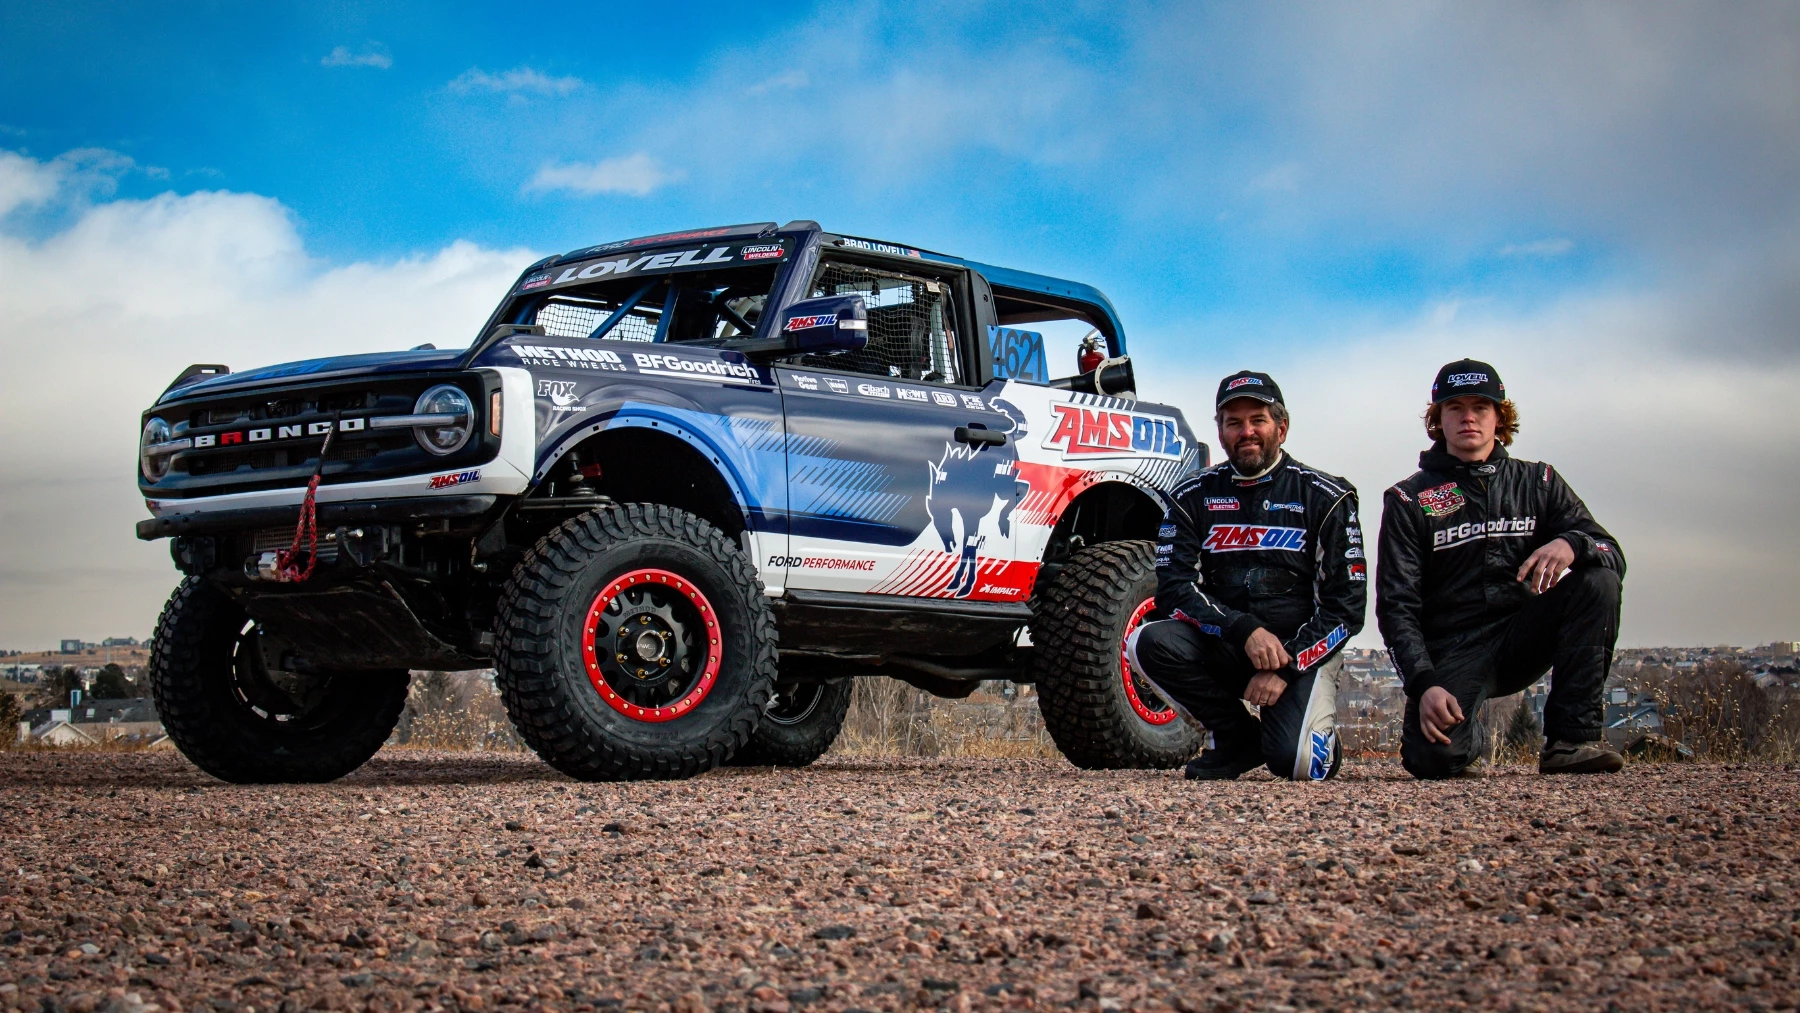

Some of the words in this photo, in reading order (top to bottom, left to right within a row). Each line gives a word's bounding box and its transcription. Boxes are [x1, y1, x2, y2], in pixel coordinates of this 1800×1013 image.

[743, 245, 779, 253] LINCOLN
[843, 238, 870, 250] BRAD
[873, 243, 905, 256] LOVELL
[552, 247, 733, 285] LOVELL
[784, 314, 838, 331] AMSOIL
[511, 345, 622, 363] METHOD
[521, 357, 560, 366] RACE
[991, 330, 1042, 382] 4621
[566, 360, 627, 371] WHEELS
[632, 352, 759, 378] BFGoodrich
[798, 381, 818, 390] Gear
[1226, 377, 1263, 391] AMSOIL
[1448, 373, 1488, 383] LOVELL
[538, 380, 577, 398] FOX
[858, 384, 890, 394] Eibach
[195, 418, 364, 448] BRONCO
[1046, 402, 1183, 458] AMSOIL
[428, 470, 481, 490] AMSOIL
[1419, 491, 1457, 507] BAJA
[1431, 496, 1464, 511] 1000
[1203, 525, 1306, 552] AMSOIL
[1433, 516, 1536, 546] BFGoodrich
[767, 556, 802, 567] FORD
[802, 557, 876, 571] PERFORMANCE
[990, 586, 1021, 595] IMPACT
[1297, 623, 1348, 670] AMSOIL
